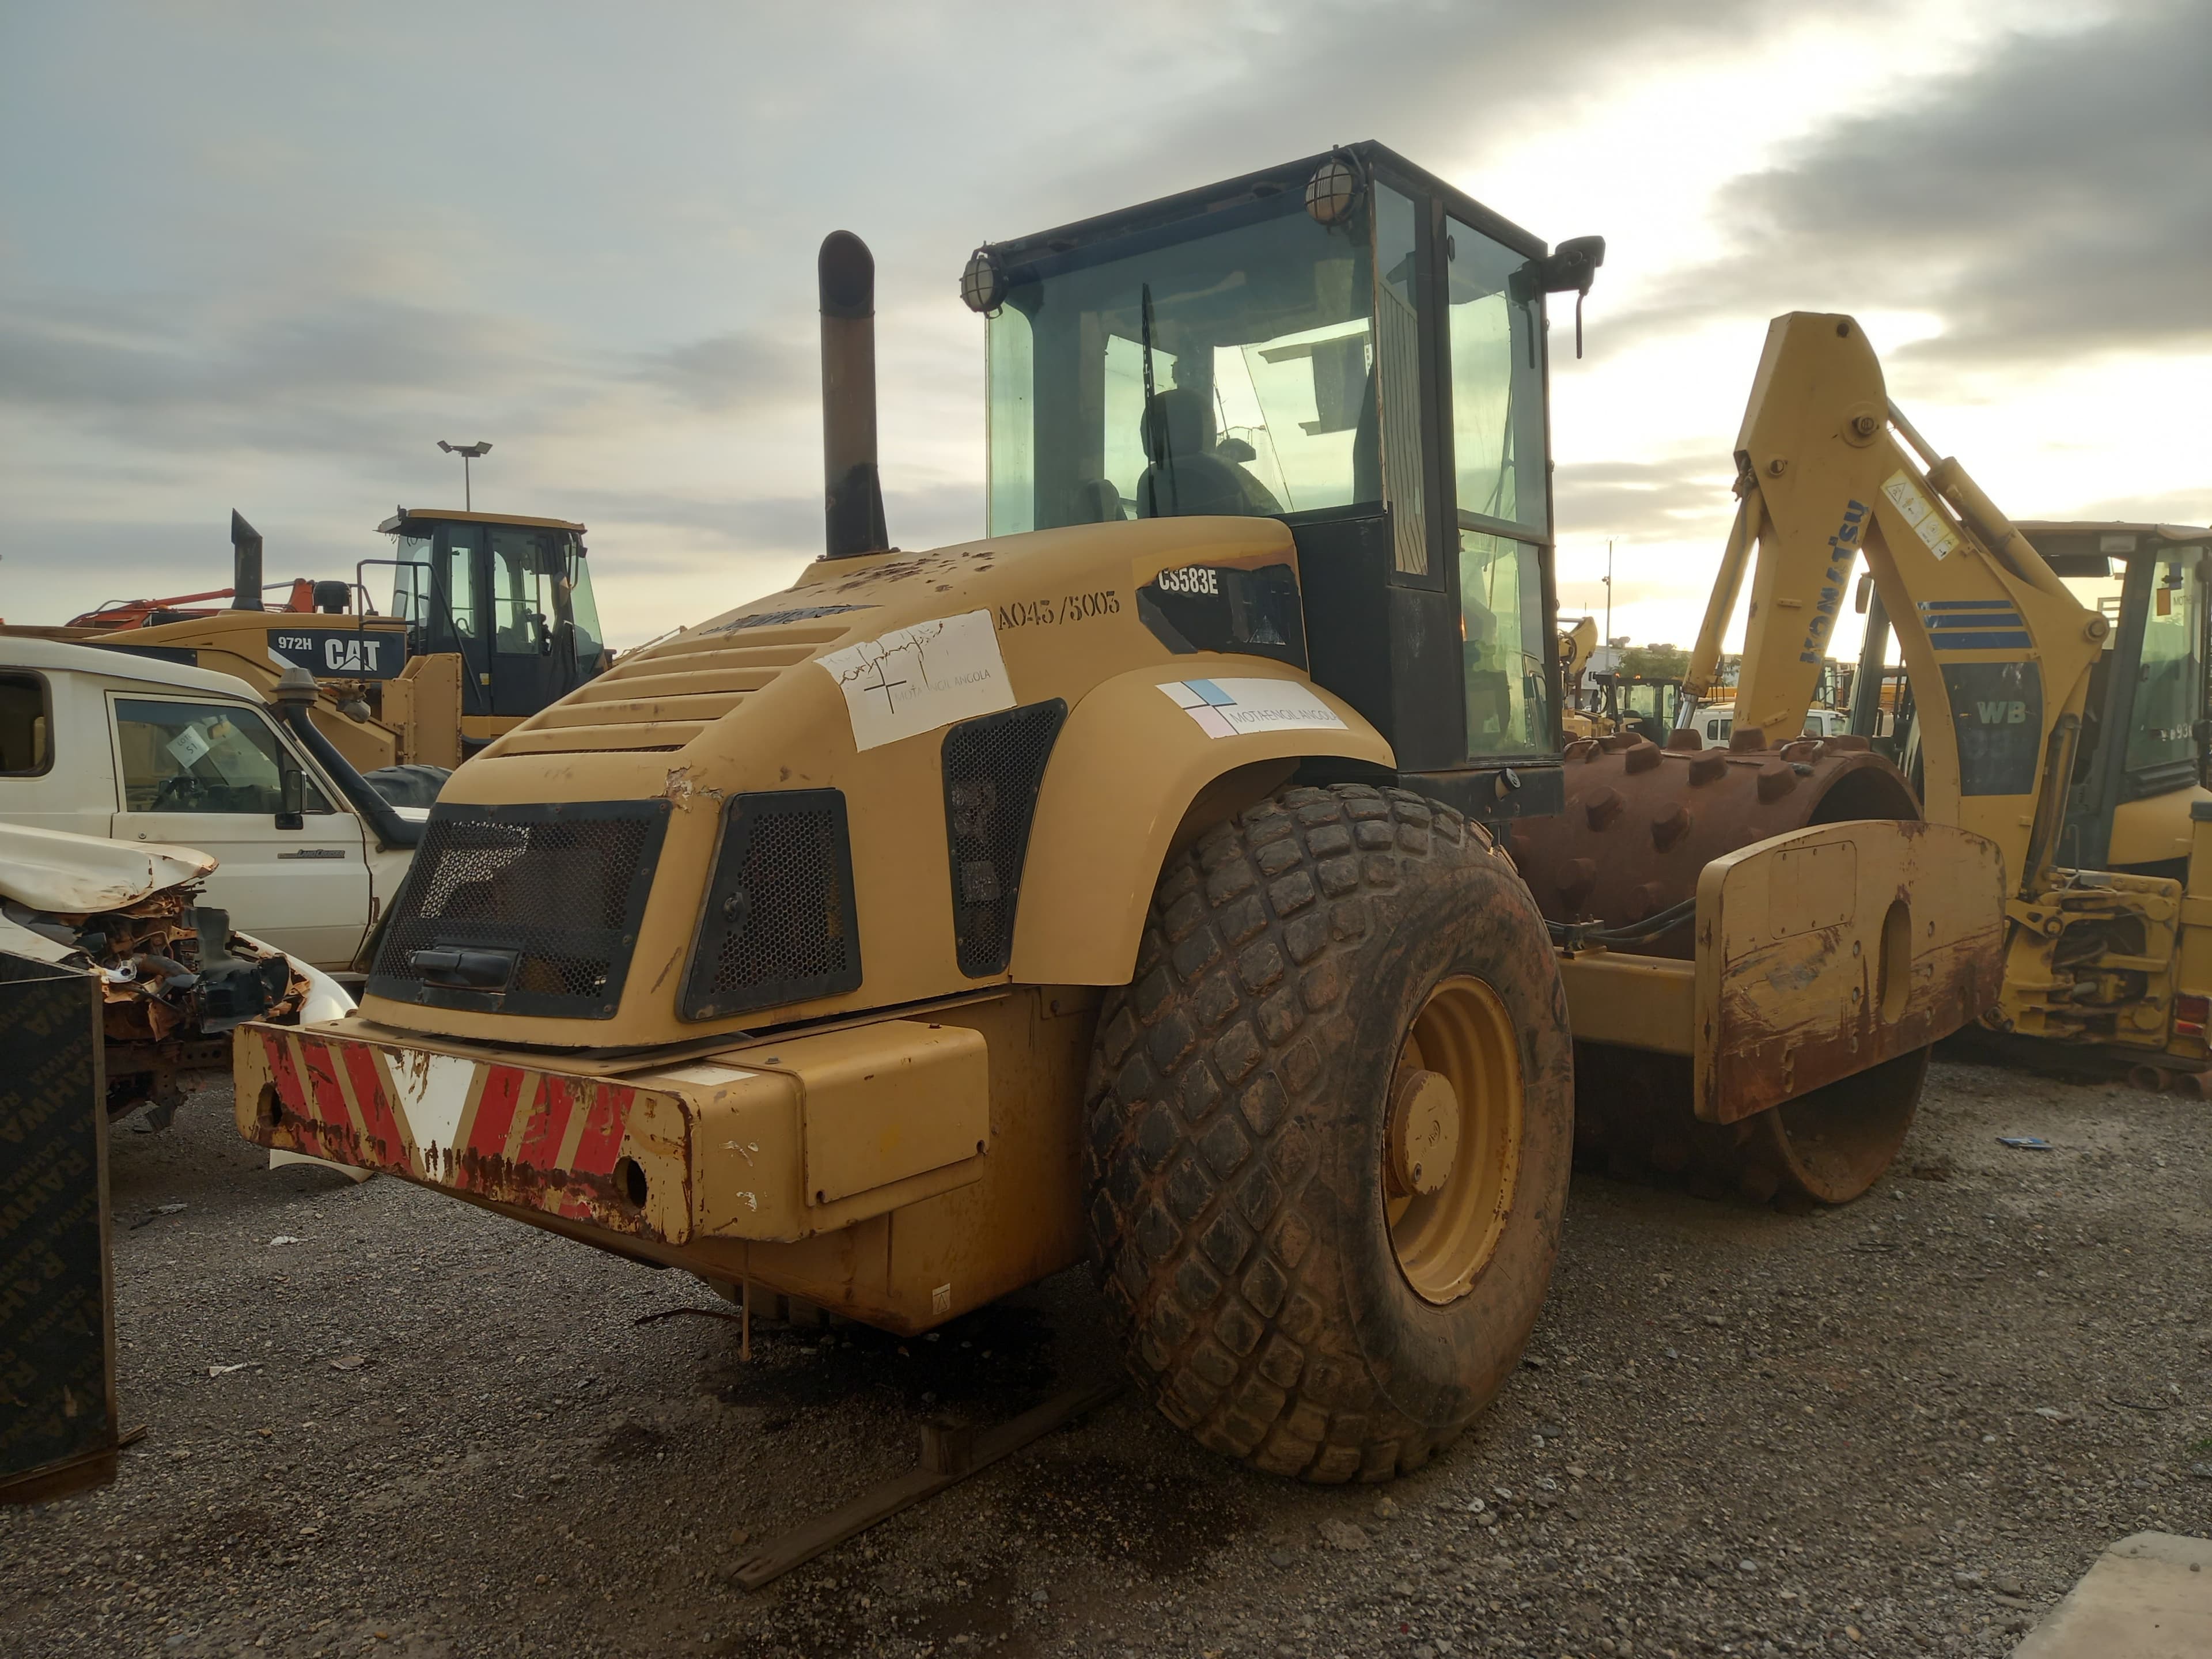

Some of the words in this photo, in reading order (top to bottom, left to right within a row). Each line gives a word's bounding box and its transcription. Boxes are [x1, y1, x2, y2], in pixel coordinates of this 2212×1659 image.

[1158, 567, 1219, 594] CS583E
[1800, 499, 1869, 664] KOMATSU
[278, 637, 312, 650] 972H
[324, 638, 380, 671] CAT
[955, 669, 991, 685] ANGOLA
[1977, 701, 2026, 724] WB
[0, 1052, 91, 1143] AHWA
[0, 1146, 91, 1240] RAHW
